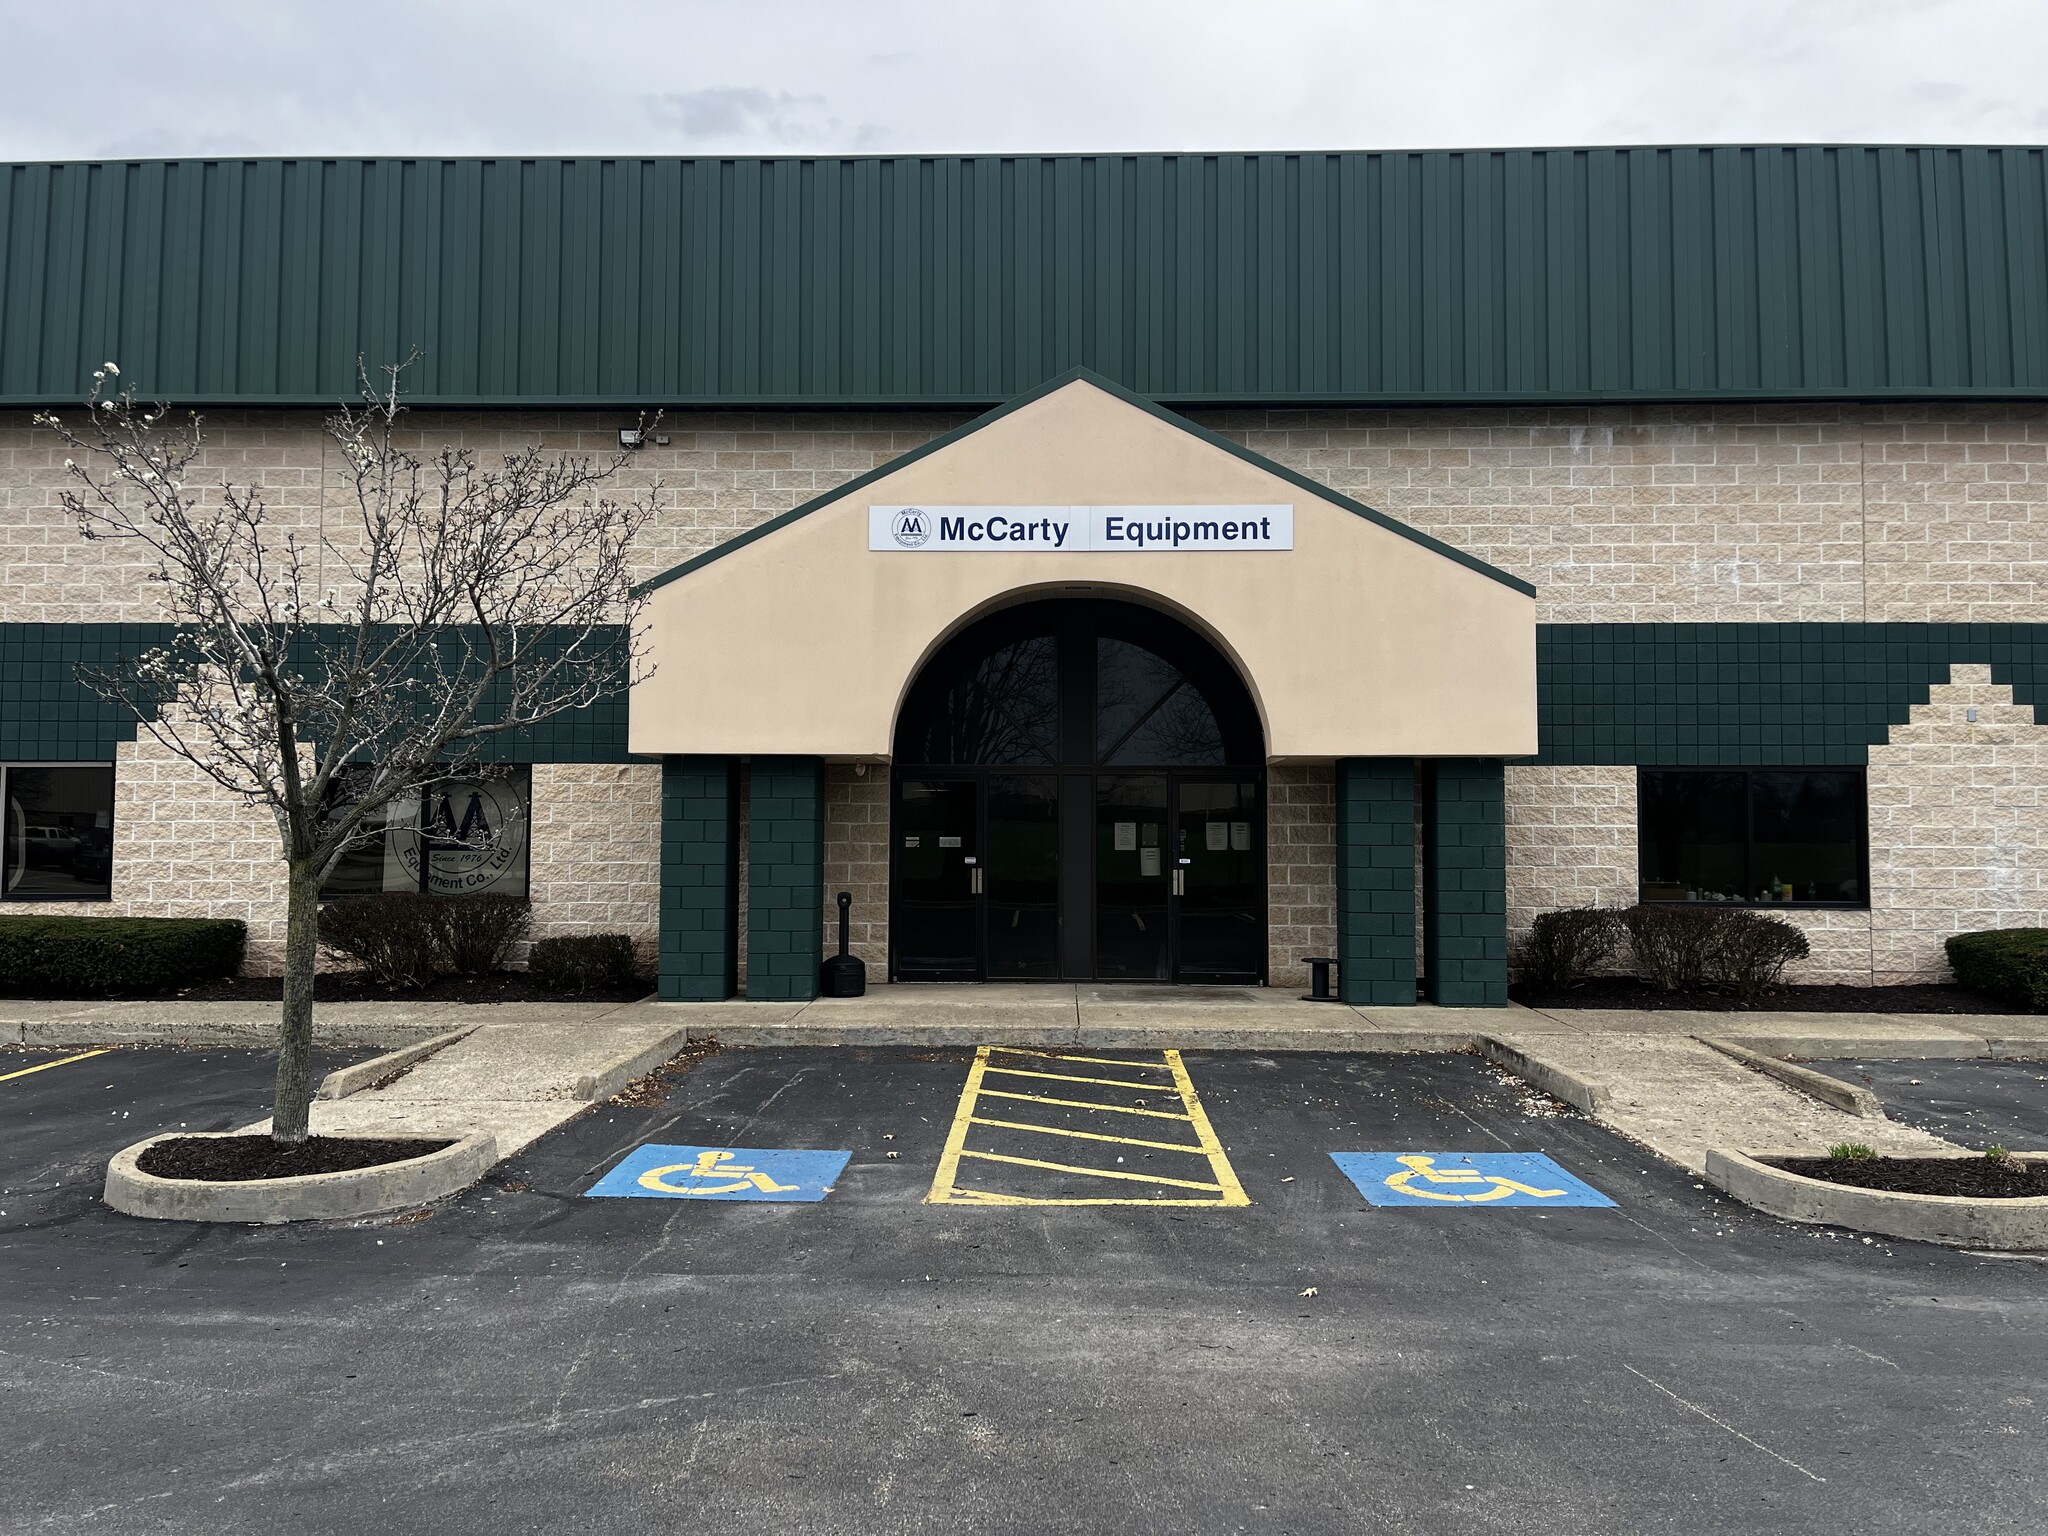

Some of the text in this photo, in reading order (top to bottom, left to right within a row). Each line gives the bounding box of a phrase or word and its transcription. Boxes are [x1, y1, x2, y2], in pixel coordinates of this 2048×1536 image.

[901, 509, 922, 517] McCarty
[940, 517, 1271, 547] McCarty Equipment
[431, 854, 483, 862] Since 1976
[403, 847, 464, 889] Equment
[490, 847, 512, 870] Ltd.
